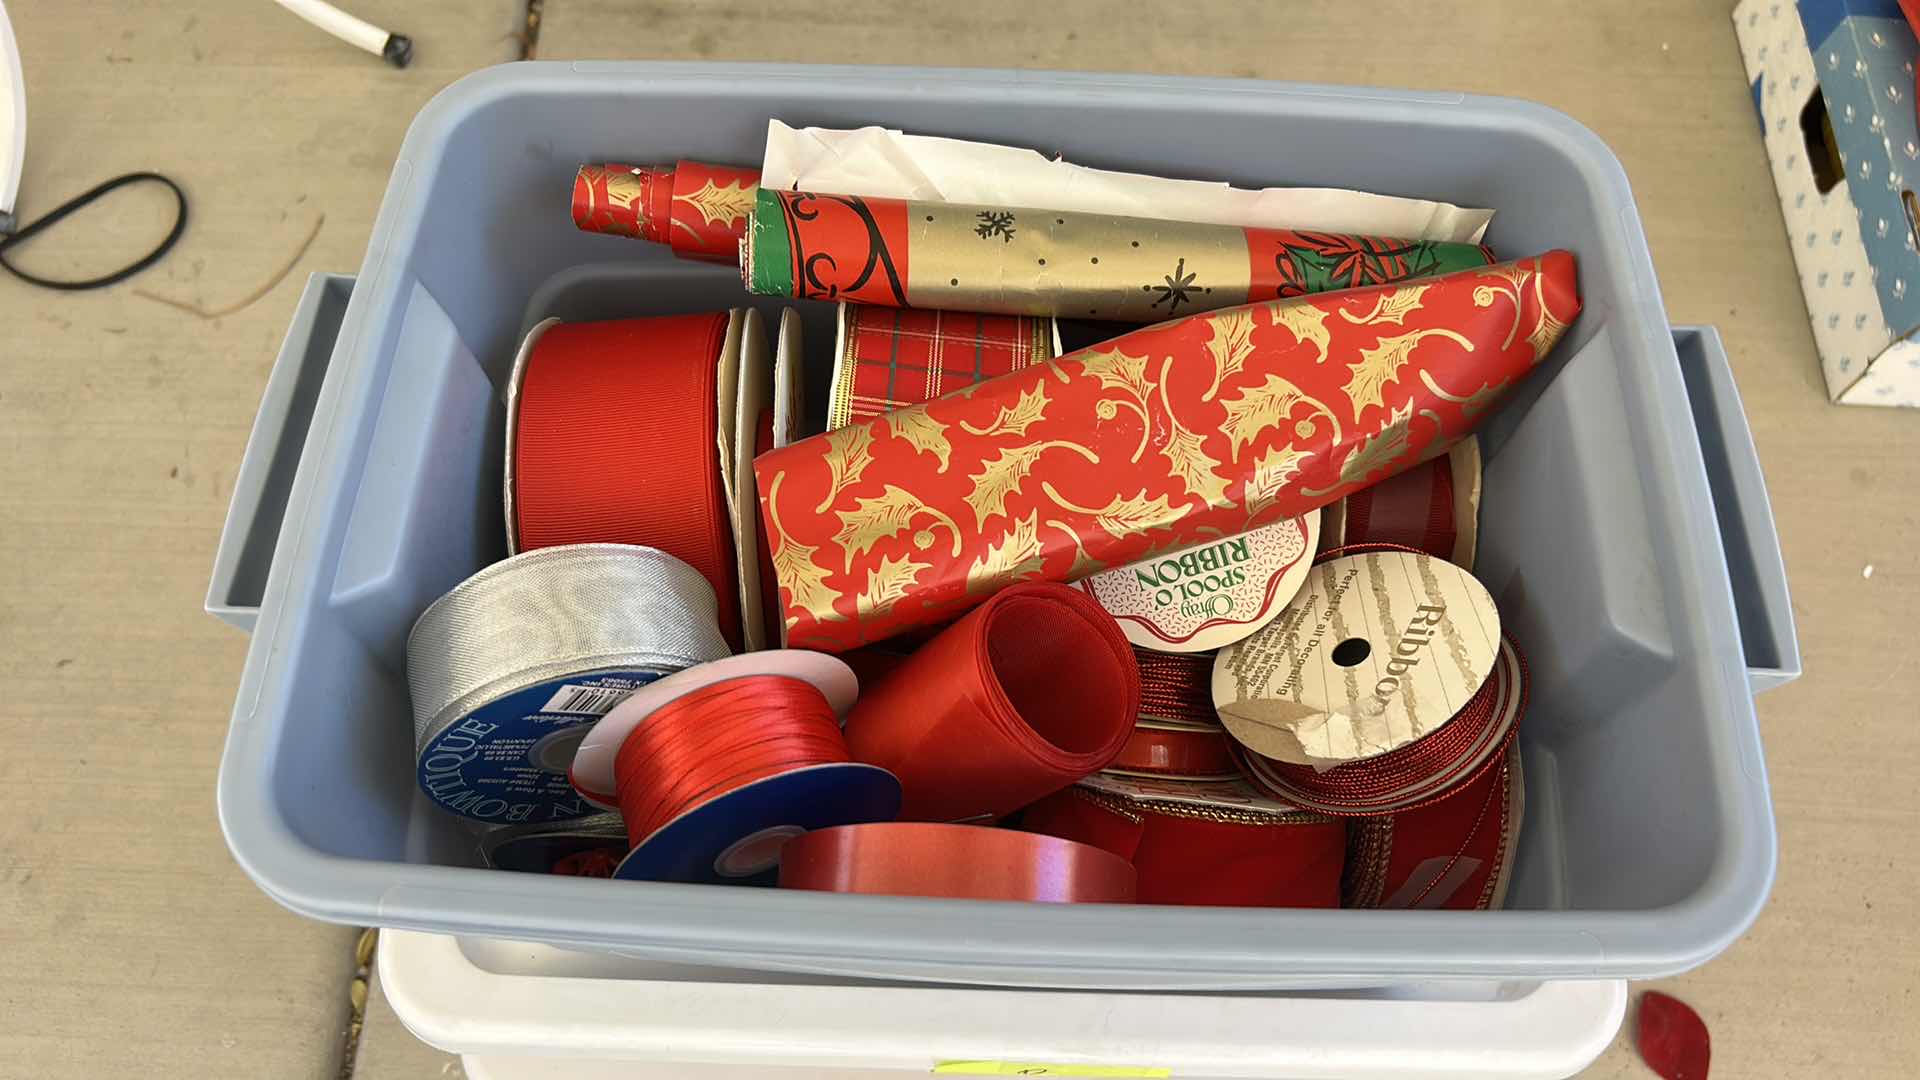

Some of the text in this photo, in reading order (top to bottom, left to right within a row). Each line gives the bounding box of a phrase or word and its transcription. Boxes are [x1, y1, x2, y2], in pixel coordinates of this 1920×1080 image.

[1134, 536, 1253, 592] RIBBON
[1173, 566, 1246, 599] SPOOL
[1333, 566, 1359, 608] Perfect
[1180, 594, 1234, 619] Offray
[1321, 605, 1336, 622] for
[1311, 621, 1327, 639] all
[1275, 636, 1319, 698] Decorating
[424, 717, 537, 821] BOWTIQUE
